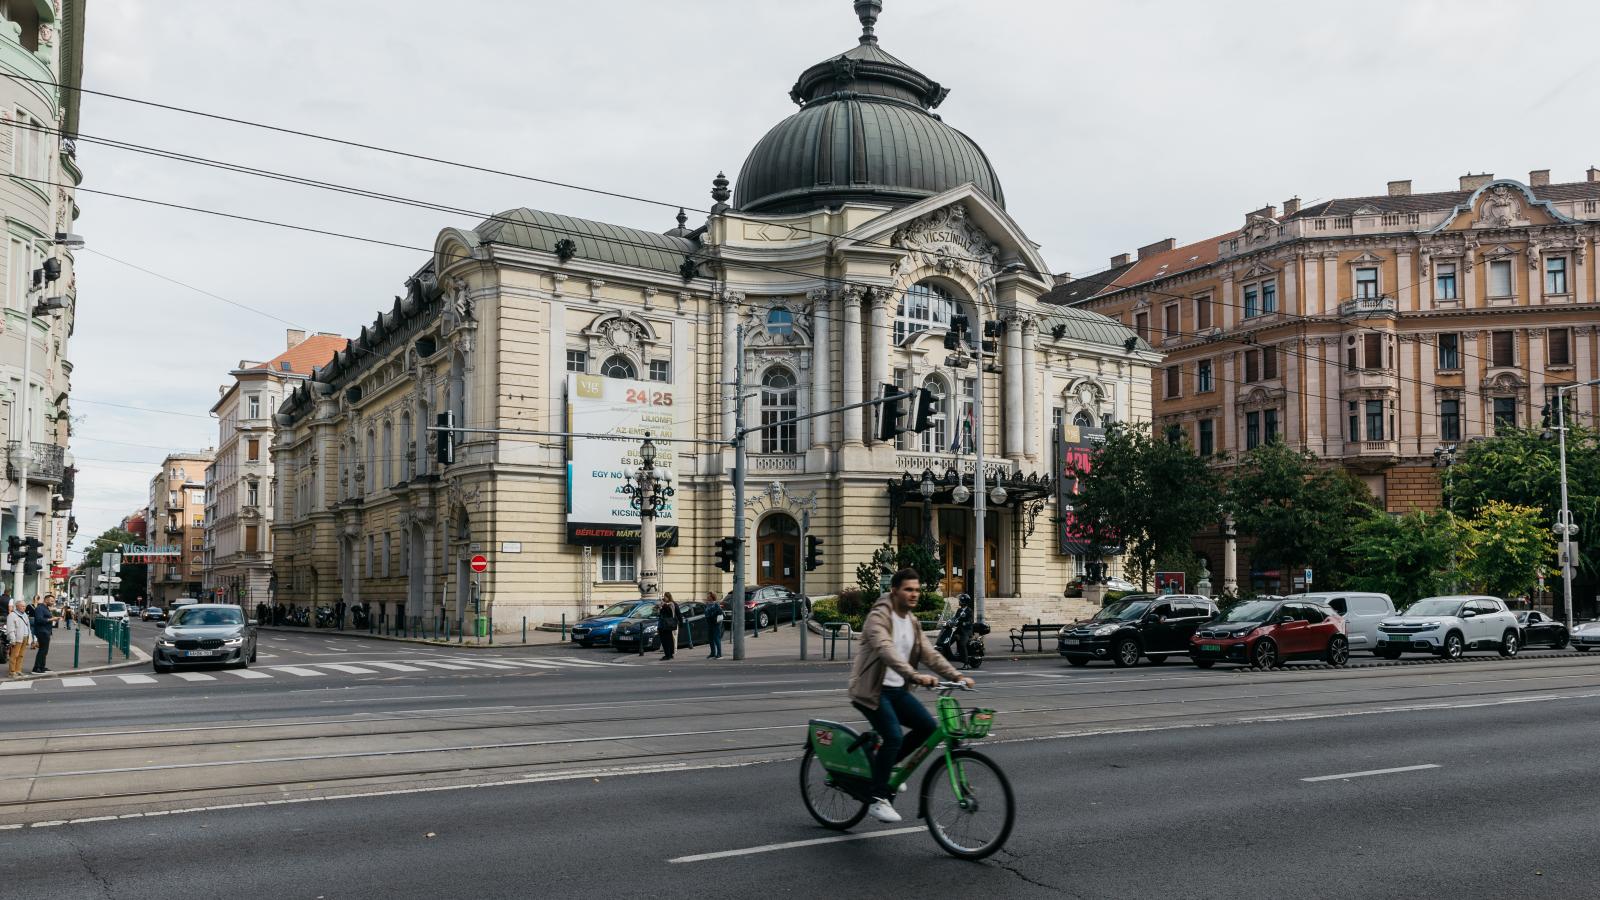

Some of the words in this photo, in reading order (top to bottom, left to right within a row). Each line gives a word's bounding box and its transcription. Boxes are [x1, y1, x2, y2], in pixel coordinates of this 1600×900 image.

[923, 231, 973, 252] VÍGSZÍNHÁZ
[626, 388, 647, 404] 24
[653, 392, 673, 407] 25
[641, 415, 673, 425] LILIOMFI
[575, 528, 614, 537] BÉRLETEK
[616, 530, 634, 538] MÁR
